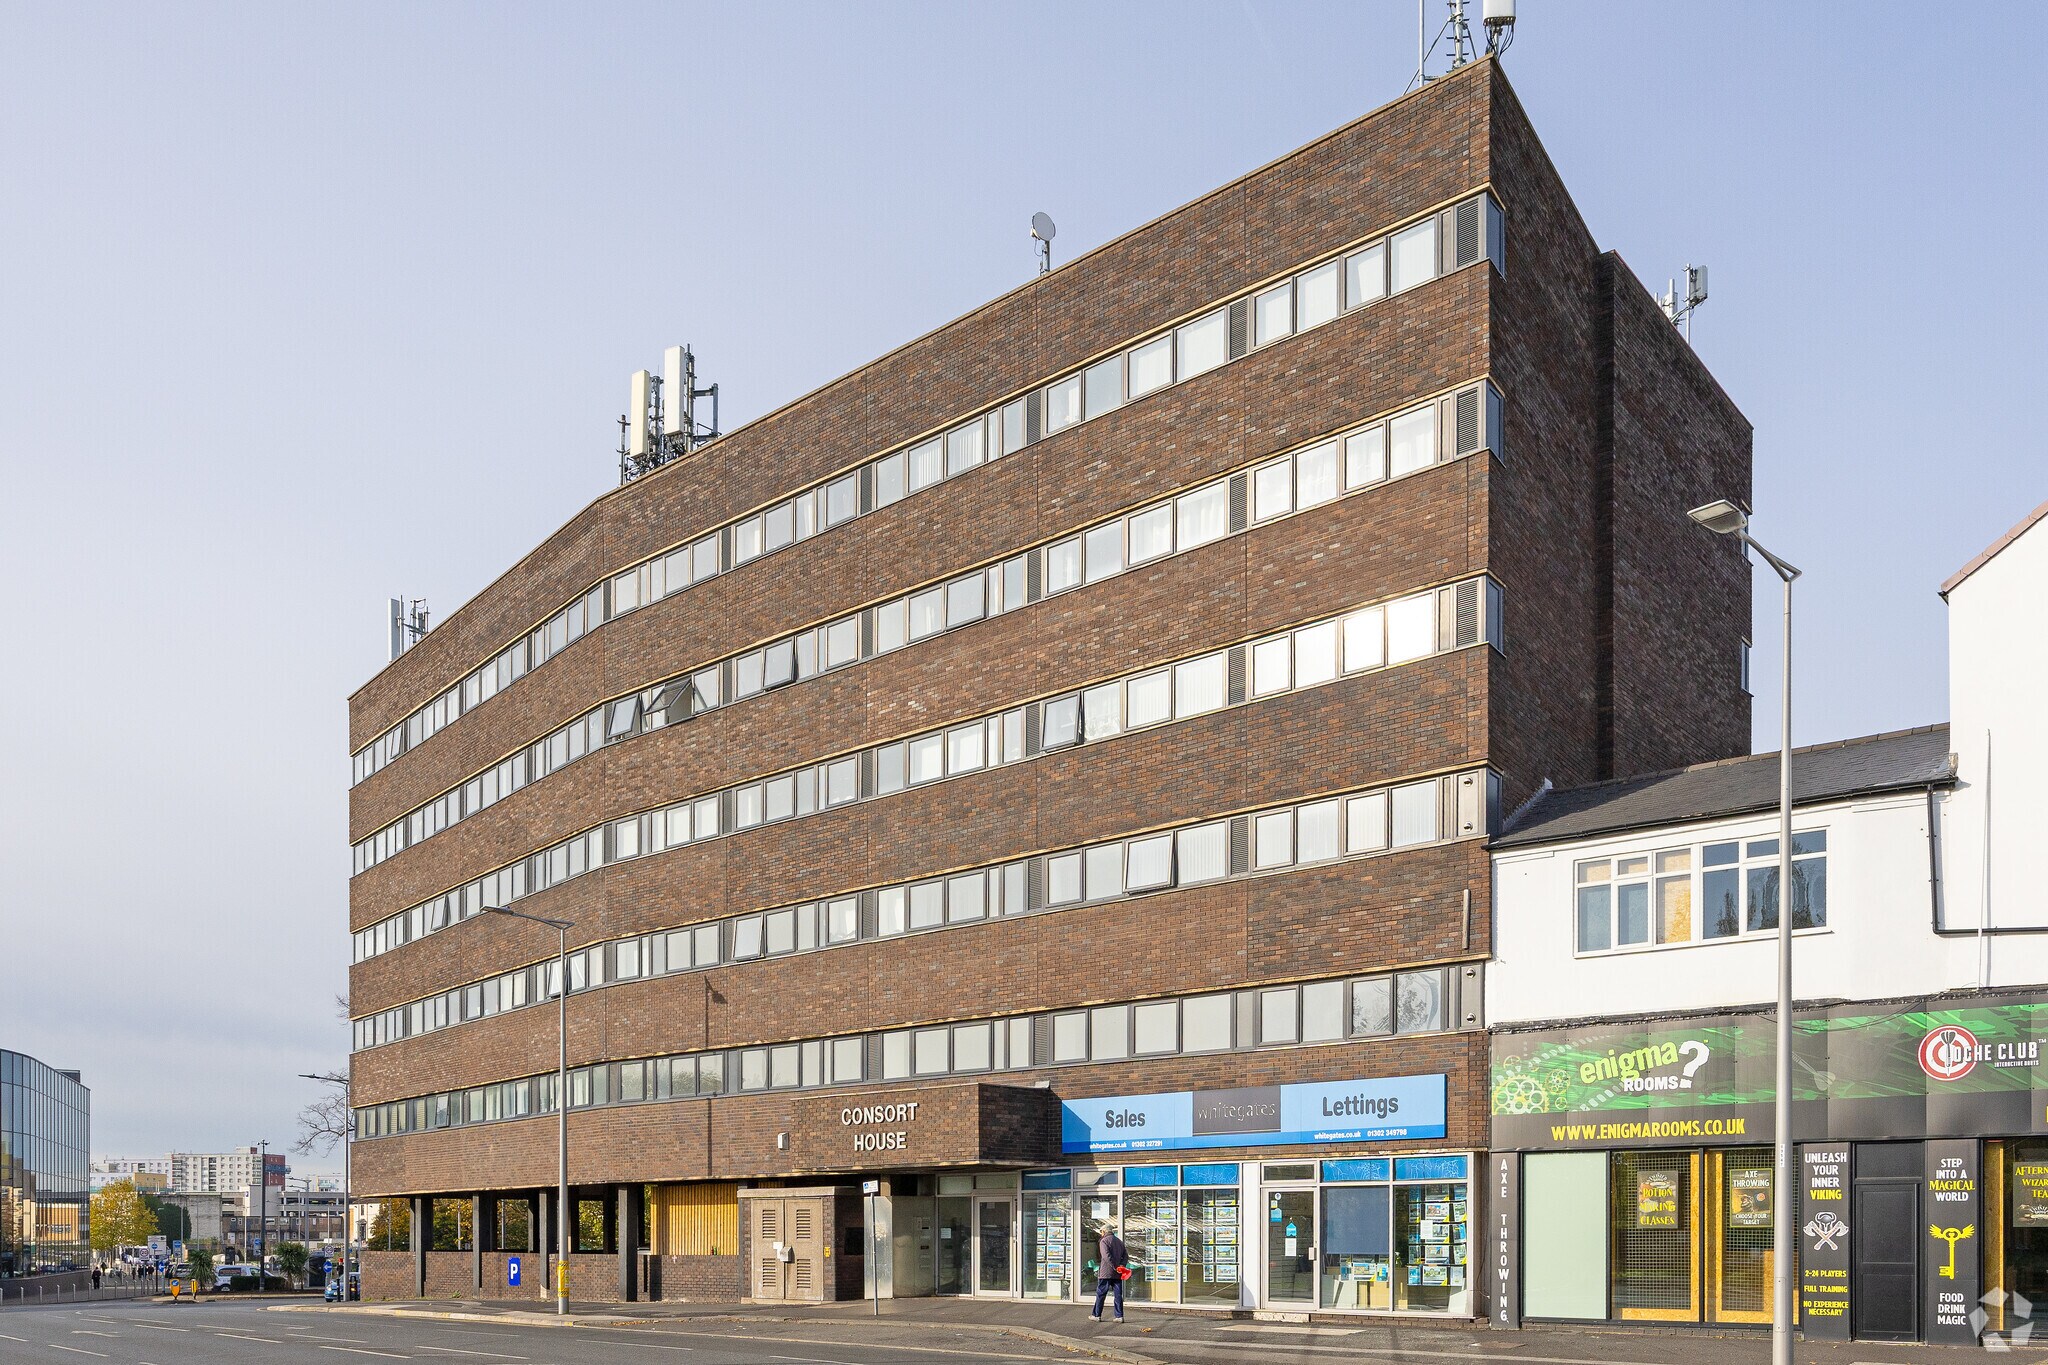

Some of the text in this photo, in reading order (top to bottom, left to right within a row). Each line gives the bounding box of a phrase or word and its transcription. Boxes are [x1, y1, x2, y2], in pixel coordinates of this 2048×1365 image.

[1998, 1042, 2037, 1060] CLUB
[1580, 1040, 1679, 1084] enigma
[1623, 1075, 1678, 1092] ROOMS
[1322, 1092, 1399, 1119] Lettings
[842, 1102, 918, 1126] CONSORT
[1197, 1101, 1276, 1122] whitegates
[1105, 1108, 1146, 1129] Sales
[1314, 1131, 1361, 1140] whitegates.co.uk
[1367, 1129, 1384, 1137] 01302
[1551, 1118, 1746, 1142] WWW.ENIGMAROOMS.CO.UK
[854, 1131, 908, 1152] HOUSE
[1805, 1152, 1847, 1164] UNLEASH
[1940, 1158, 1962, 1168] STEP
[1744, 1170, 1758, 1178] AXE
[1813, 1165, 1838, 1175] YOUR
[1936, 1169, 1967, 1180] INTO A
[1500, 1158, 1508, 1198] AXE
[1812, 1178, 1840, 1188] INNER
[1733, 1179, 1770, 1188] THROWING
[1929, 1180, 1975, 1191] MAGICAL
[1643, 1188, 1673, 1198] POTION
[1810, 1190, 1842, 1200] VIKING
[1936, 1192, 1969, 1201] WORLD
[1640, 1215, 1675, 1225] CLASSES
[510, 1264, 518, 1280] P
[1498, 1214, 1510, 1322] THROWING
[1820, 1270, 1847, 1278] PLAYERS
[1820, 1285, 1848, 1293] TRAINING
[1940, 1293, 1964, 1303] FOOD
[1814, 1301, 1848, 1309] EXPERIENCE
[1938, 1304, 1966, 1314] DRINK
[1808, 1308, 1843, 1316] NECESSARY
[1938, 1315, 1966, 1325] MAGIC
